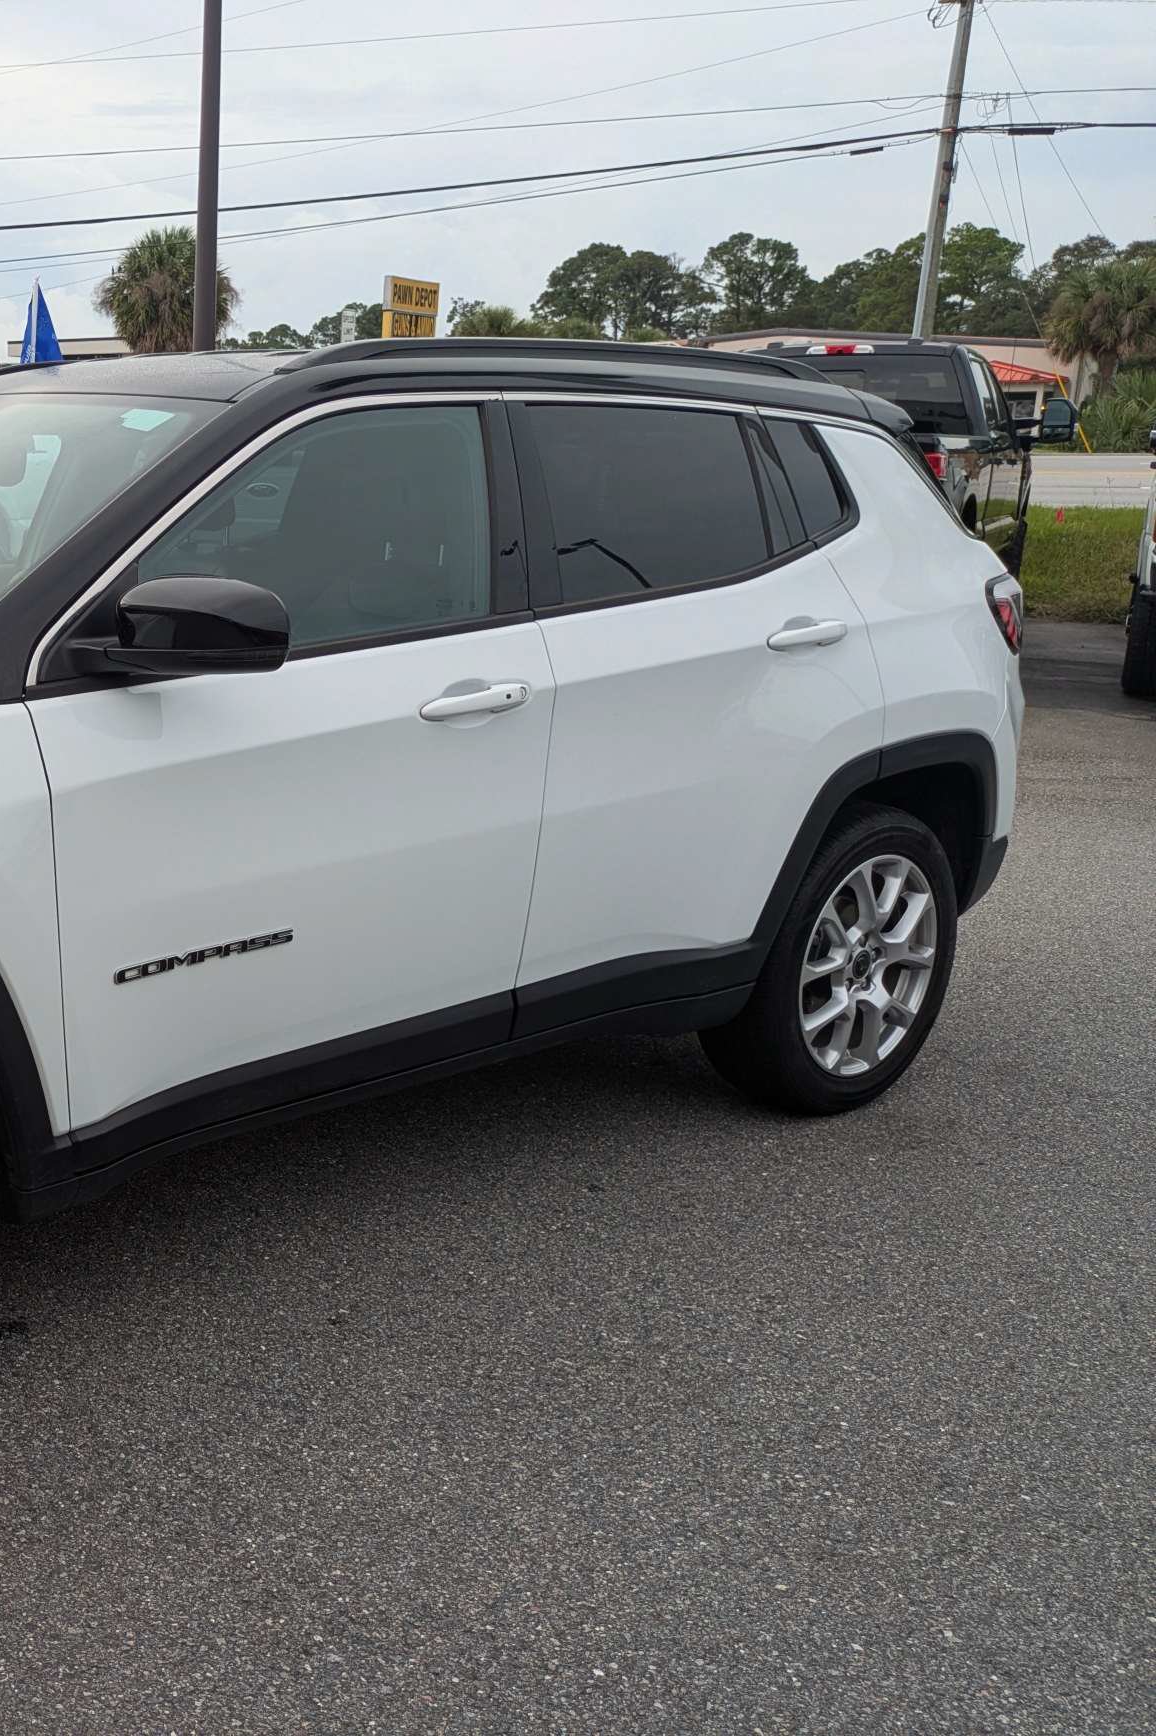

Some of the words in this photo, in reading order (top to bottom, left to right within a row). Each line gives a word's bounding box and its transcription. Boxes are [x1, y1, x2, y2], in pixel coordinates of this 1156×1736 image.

[392, 283, 413, 305] PAWN
[415, 286, 438, 309] DEPOT
[392, 313, 411, 335] GUNS
[113, 927, 294, 986] COMPASS
